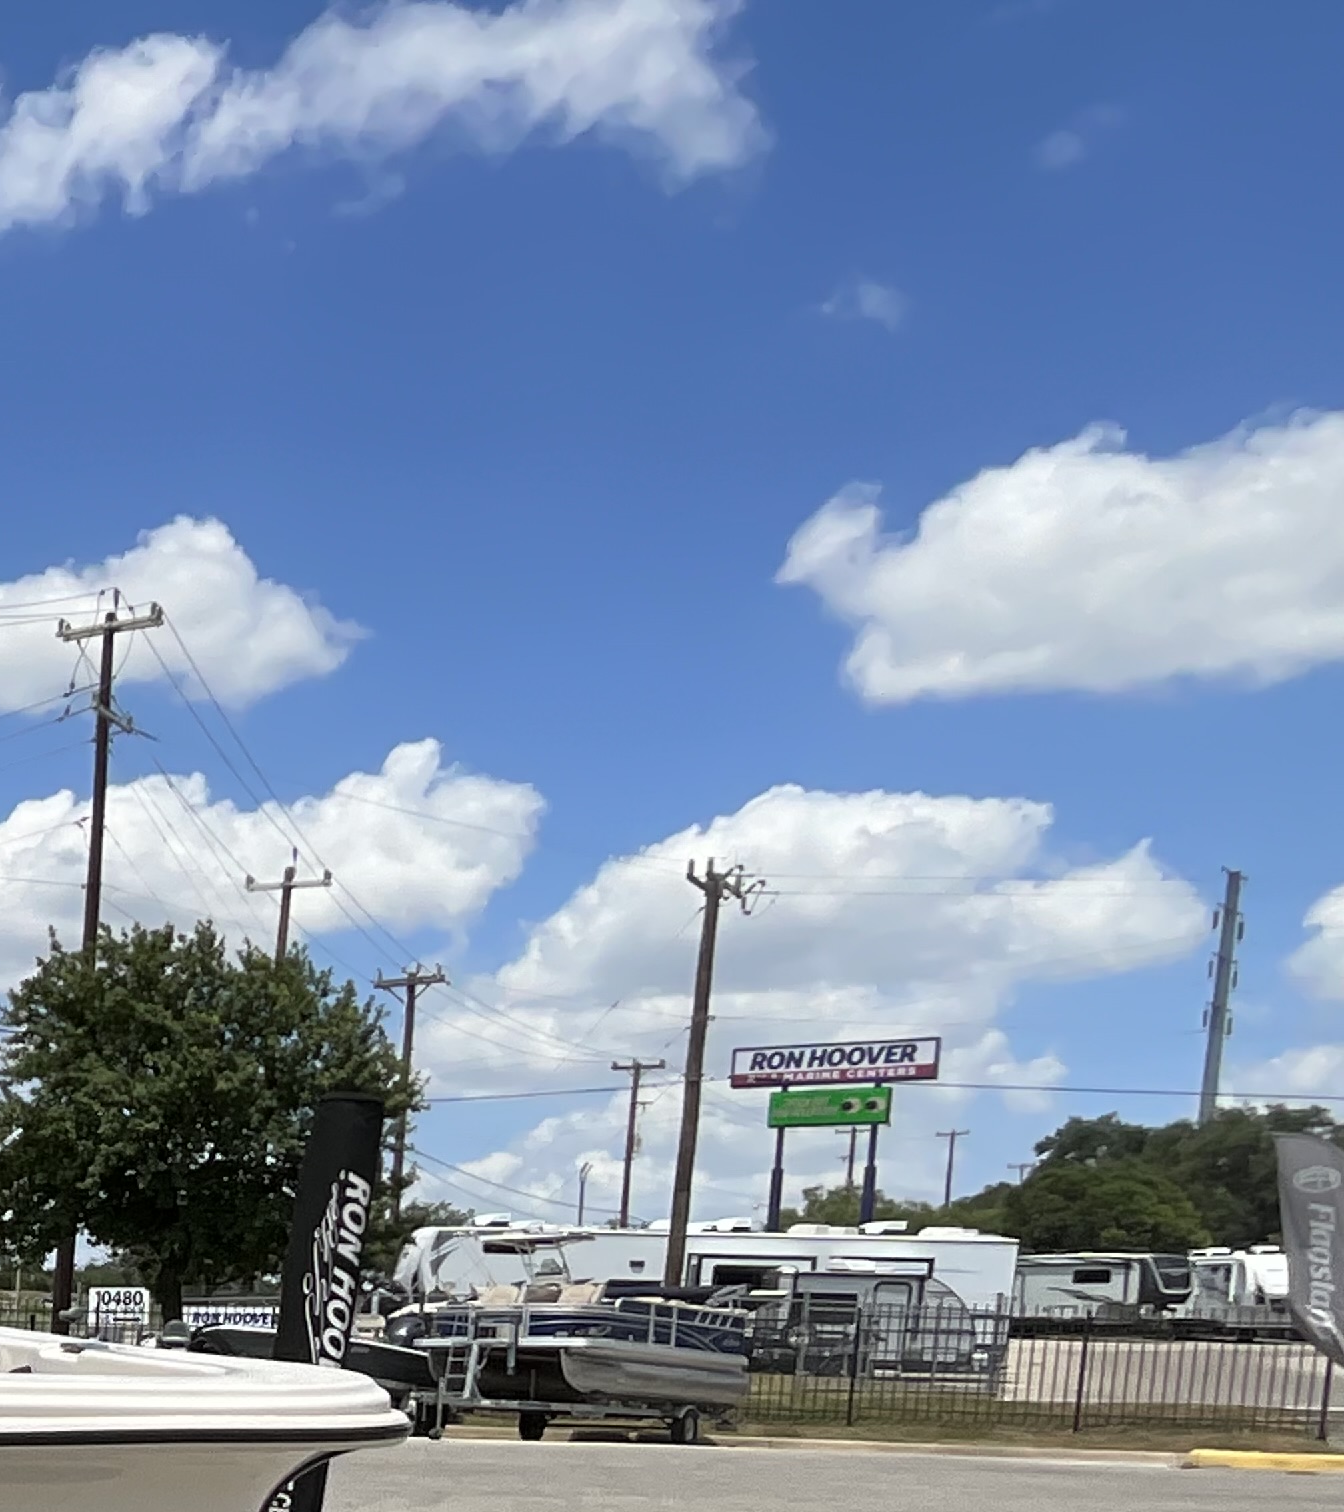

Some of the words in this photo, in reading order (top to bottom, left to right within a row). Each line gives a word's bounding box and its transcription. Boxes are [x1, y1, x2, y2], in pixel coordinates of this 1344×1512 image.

[749, 1050, 805, 1071] RON
[807, 1043, 918, 1069] HOOVER
[782, 1070, 841, 1082] MARINE
[846, 1067, 917, 1079] CENTERS
[336, 1169, 372, 1267] RON
[95, 1290, 144, 1306] 10480
[223, 1312, 275, 1327] HOOVE
